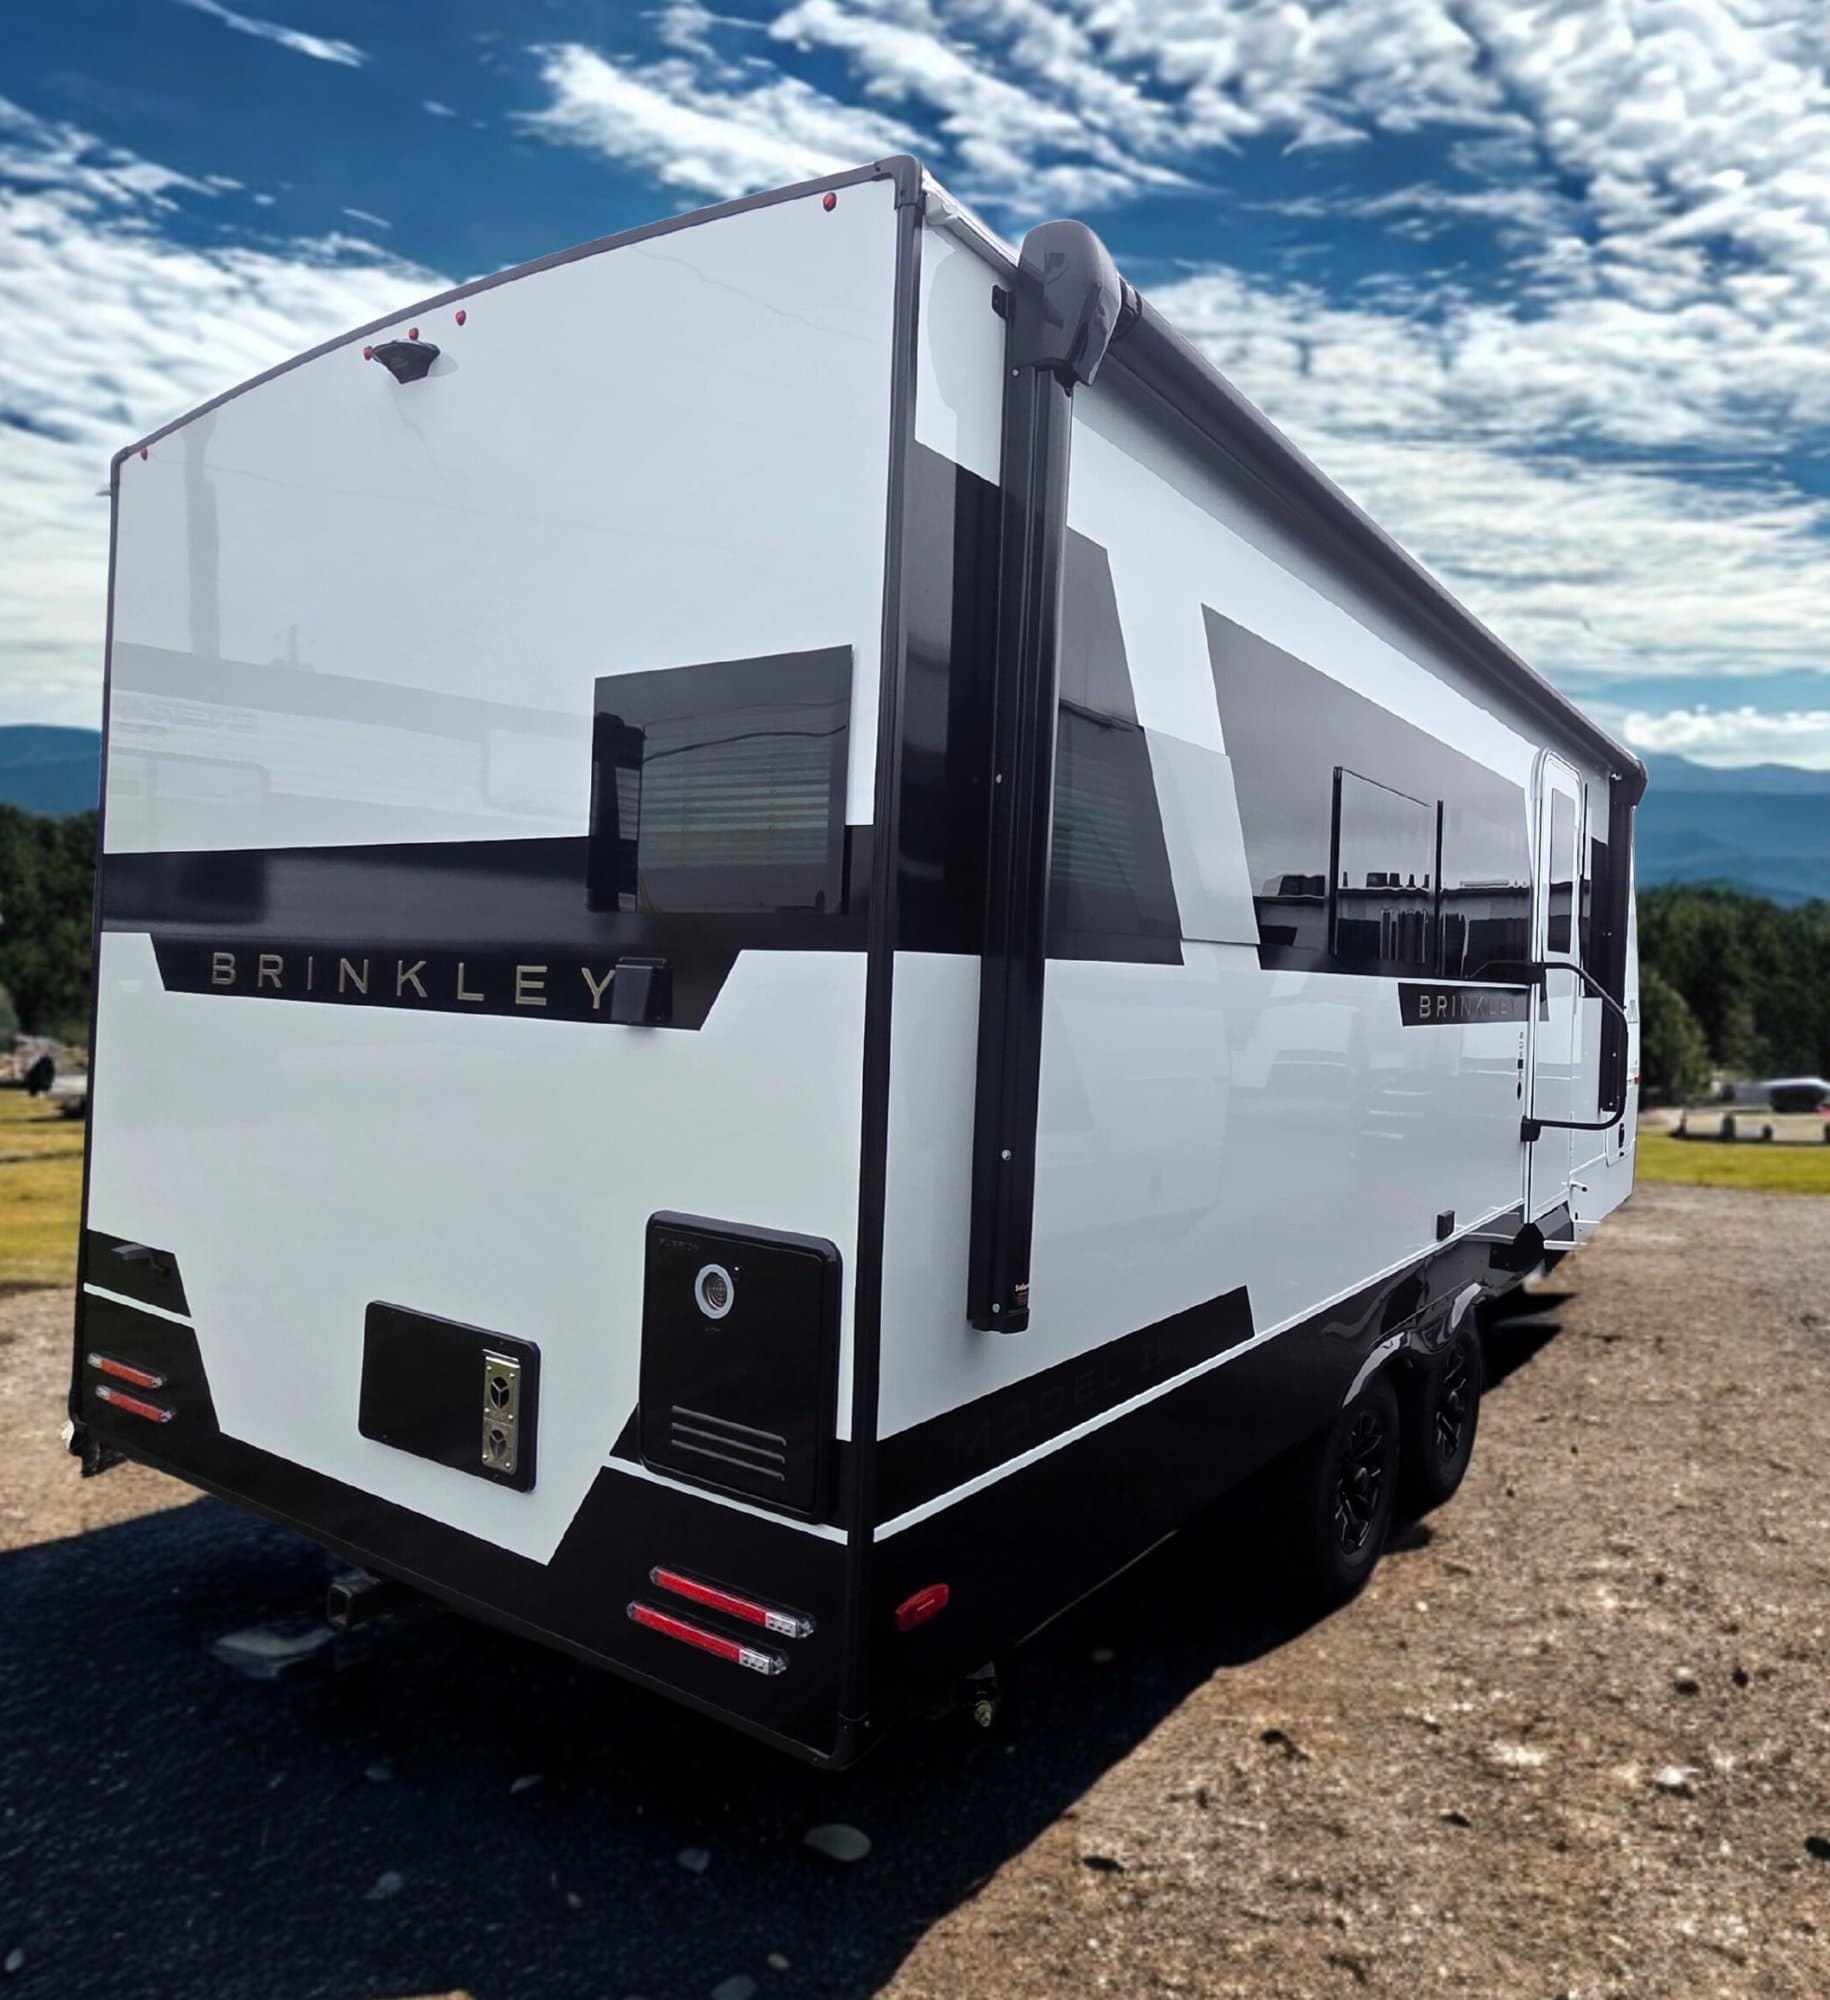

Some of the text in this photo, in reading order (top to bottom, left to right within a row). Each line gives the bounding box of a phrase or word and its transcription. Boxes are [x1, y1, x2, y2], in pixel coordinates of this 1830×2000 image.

[211, 952, 616, 1010] BRINKLEY
[1418, 994, 1519, 1019] BRINKLEY
[953, 1360, 1121, 1465] MODEL
